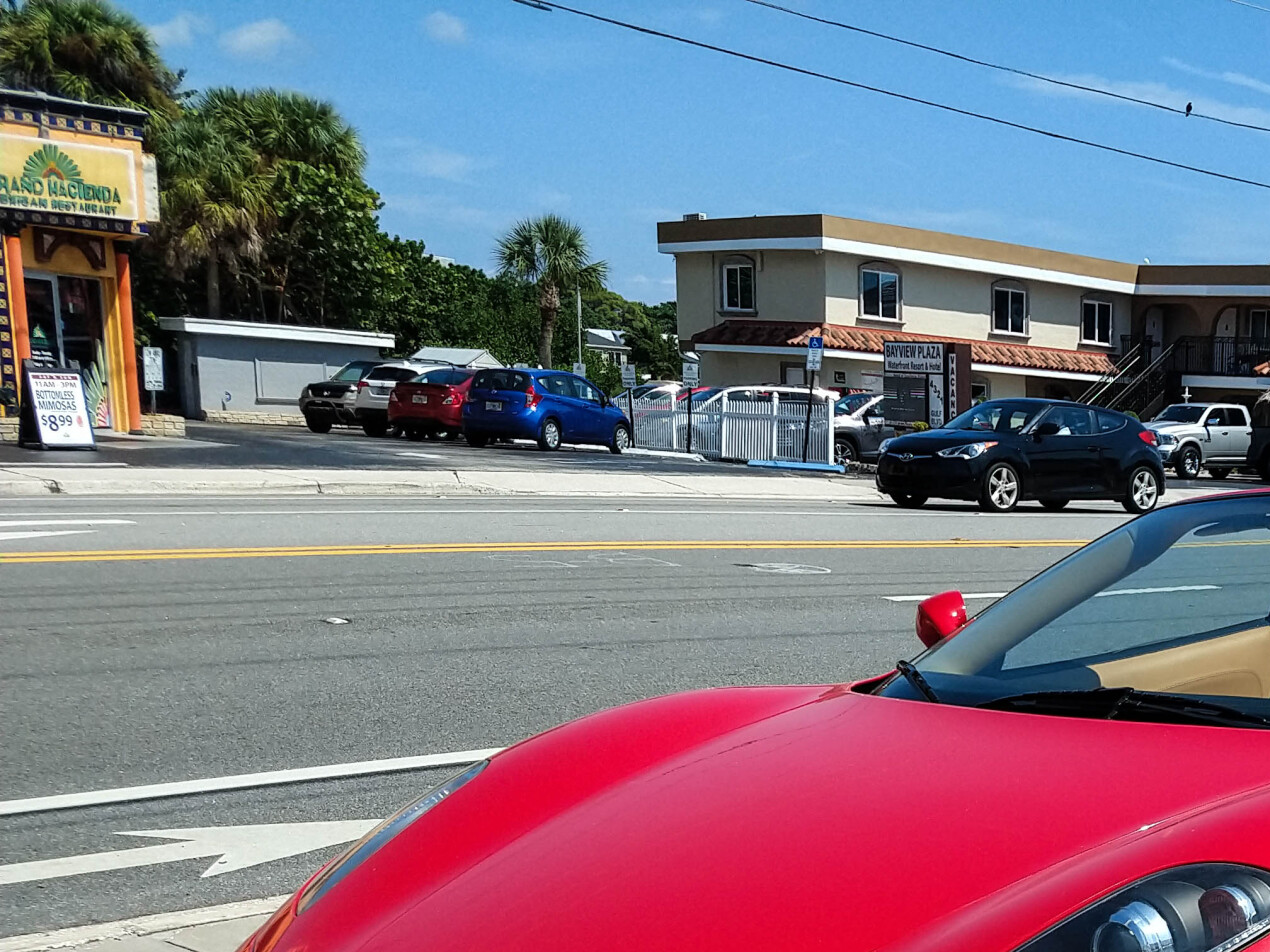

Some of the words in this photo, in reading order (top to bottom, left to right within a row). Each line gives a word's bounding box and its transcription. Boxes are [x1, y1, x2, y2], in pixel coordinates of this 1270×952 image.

[0, 174, 44, 196] RAND
[48, 178, 121, 205] HACIENDA
[0, 194, 48, 209] EXICAN
[886, 345, 917, 359] BAYVIEW
[918, 346, 941, 359] PLAZA
[35, 390, 75, 400] BOTTOMLESS
[37, 400, 77, 411] MIMOSAS
